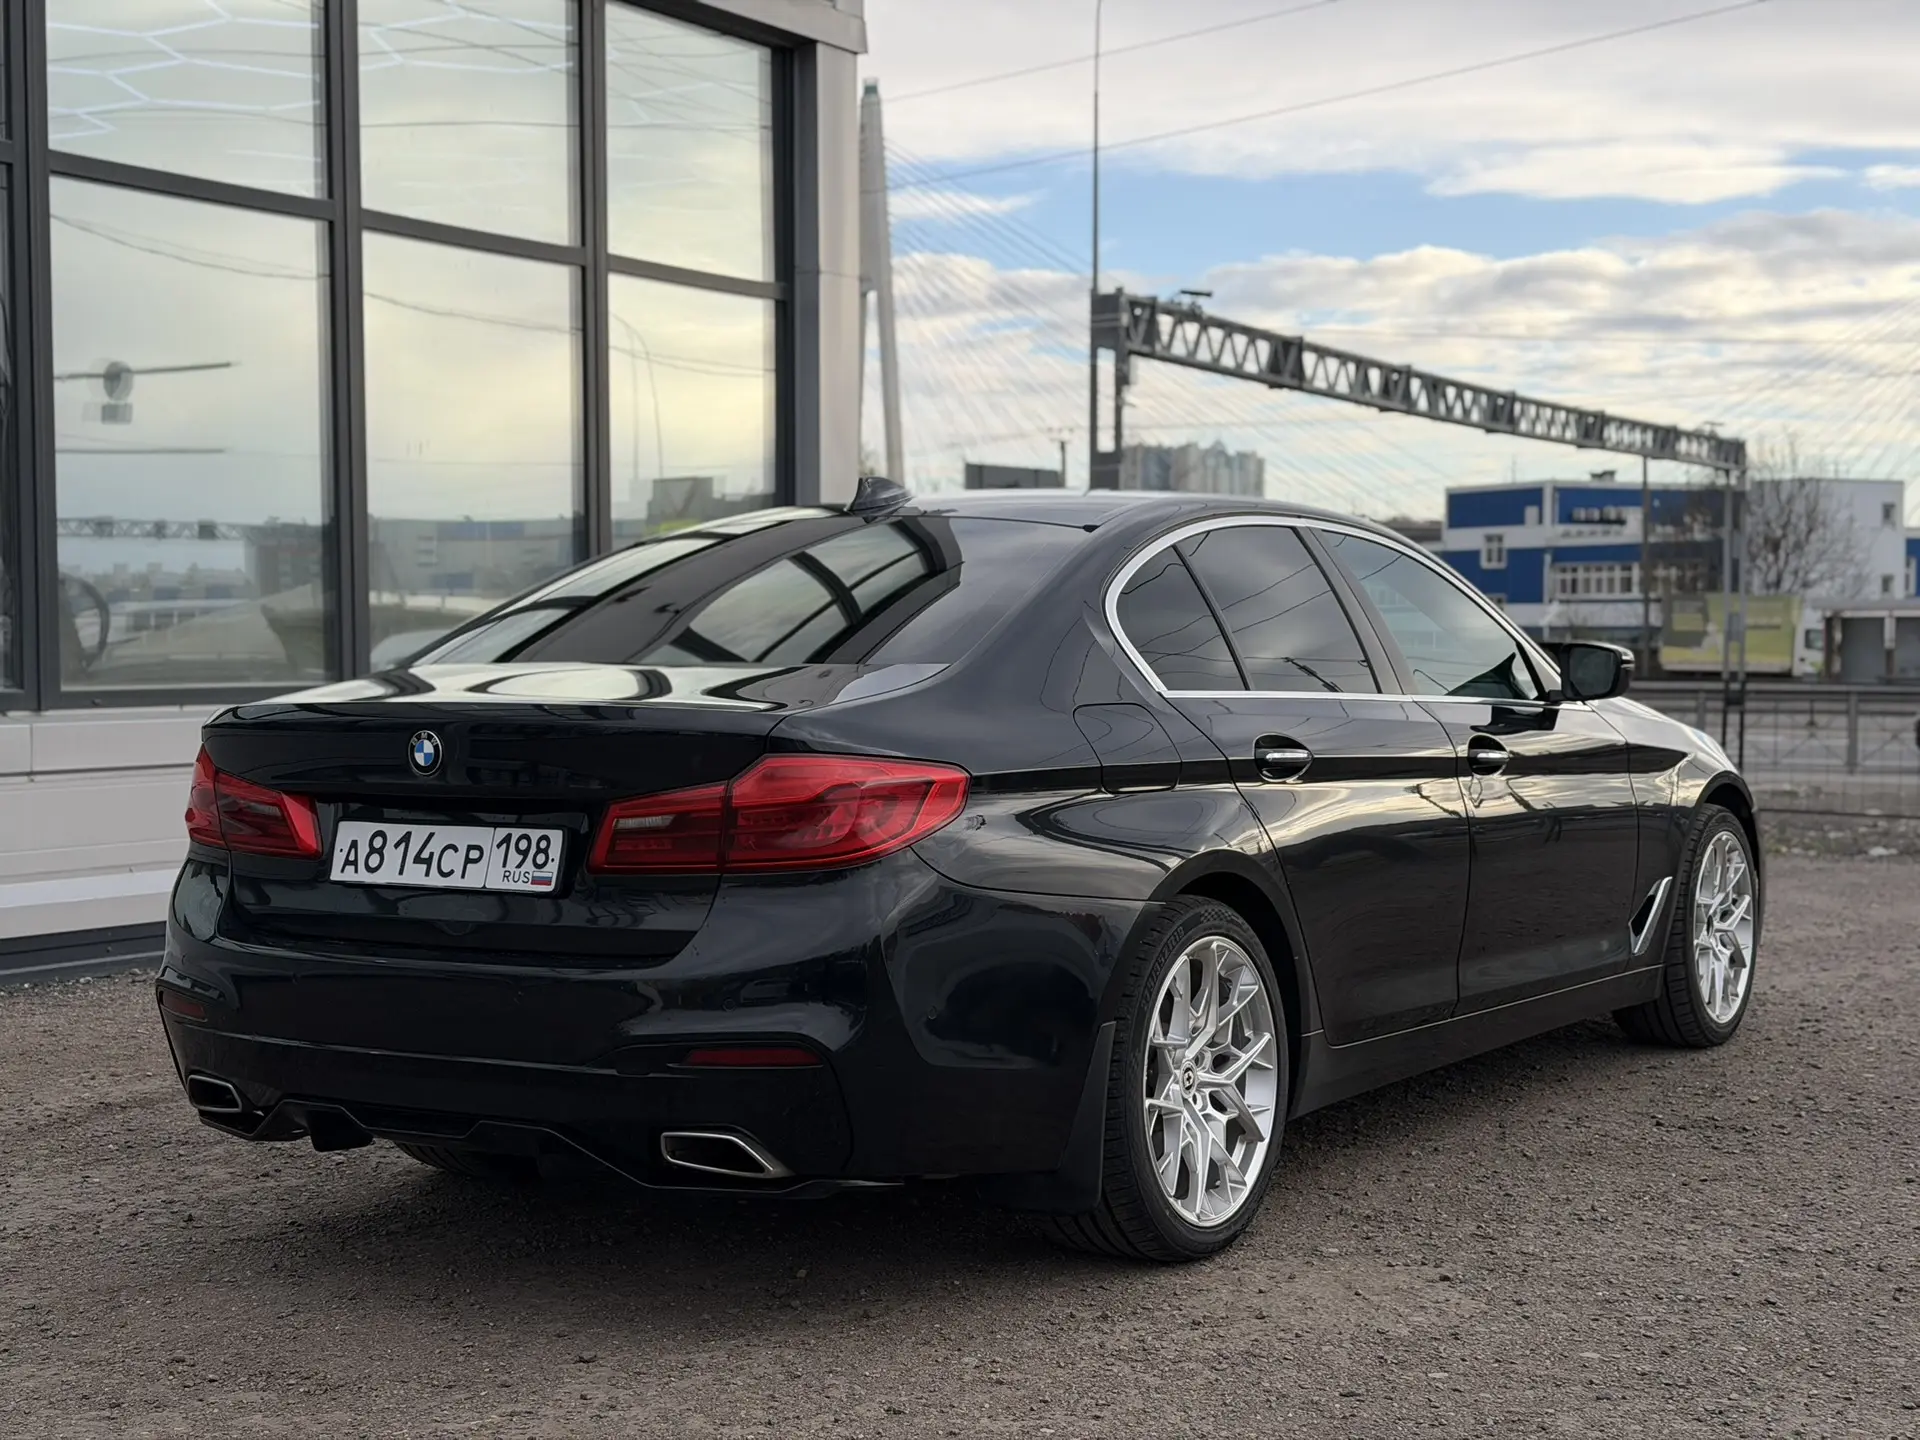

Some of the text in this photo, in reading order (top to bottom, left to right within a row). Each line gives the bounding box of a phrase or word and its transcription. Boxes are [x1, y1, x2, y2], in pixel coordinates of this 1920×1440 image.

[341, 830, 551, 879] А814СР 198
[502, 871, 530, 884] RUS
